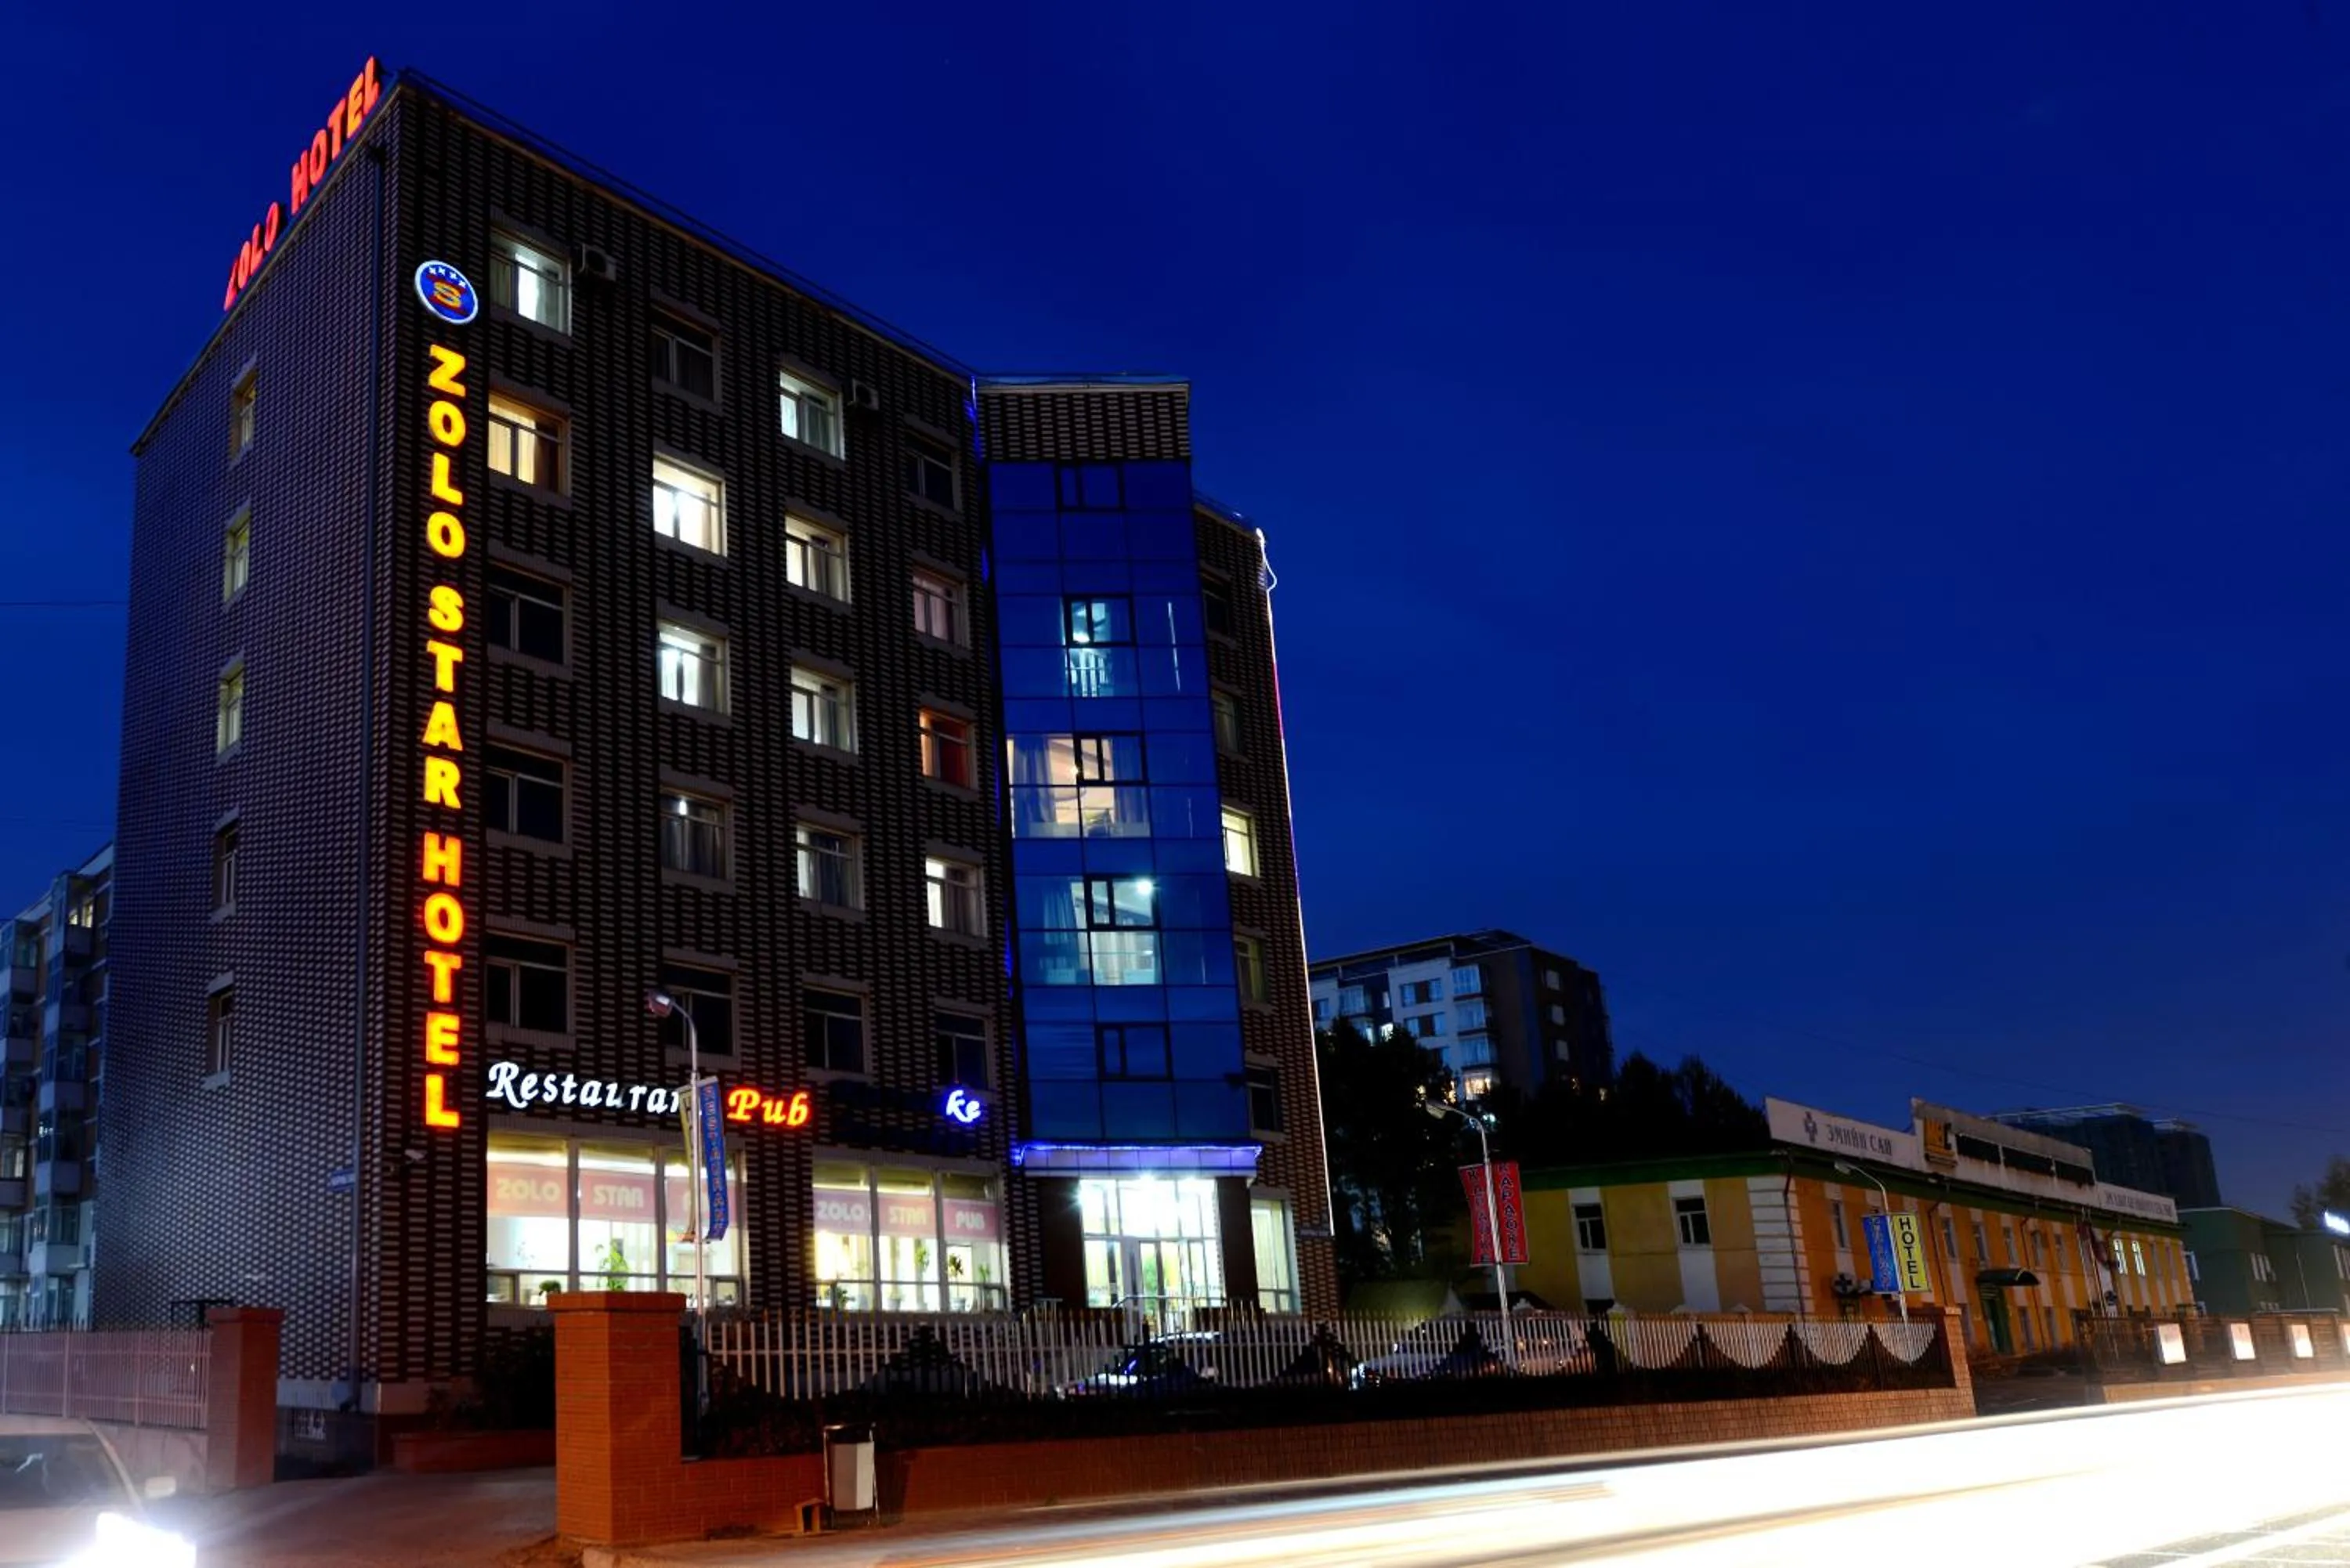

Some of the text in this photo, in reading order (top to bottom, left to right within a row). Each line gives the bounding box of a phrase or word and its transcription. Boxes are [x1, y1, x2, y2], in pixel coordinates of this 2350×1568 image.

[291, 56, 380, 215] HOTEL
[421, 344, 466, 1128] ZOLO STAR HOTEL
[486, 1061, 679, 1114] Restaura
[727, 1088, 809, 1126] Pub
[496, 1177, 645, 1209] ZOLO STAR
[816, 1201, 985, 1230] ZOLO STAR PUB
[1899, 1216, 1922, 1288] HOTEL
